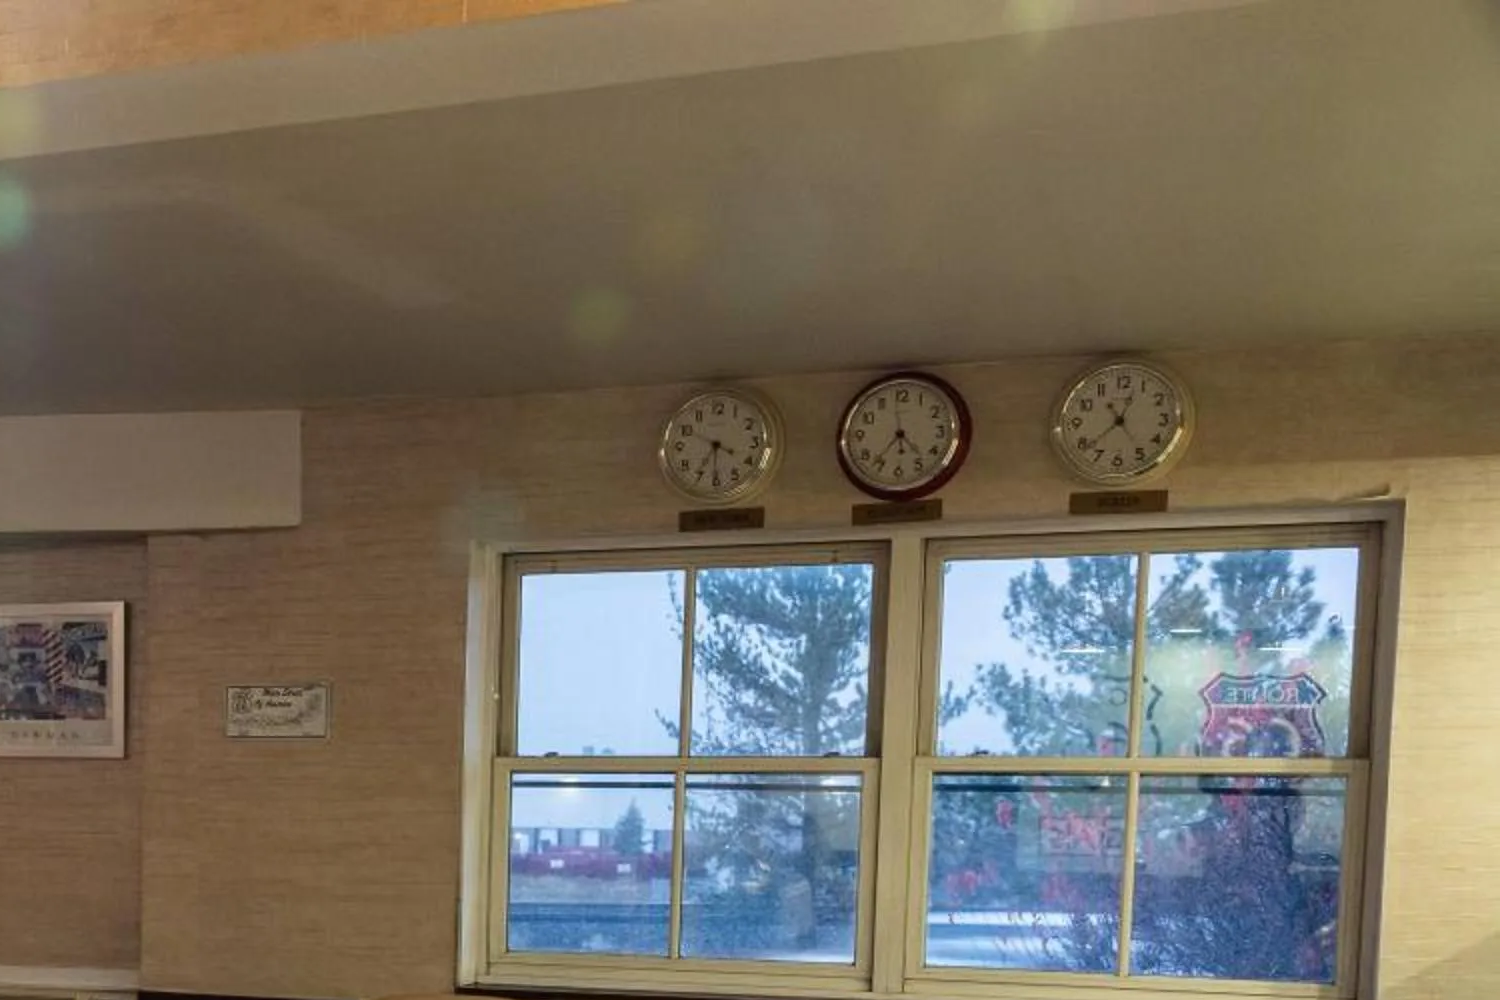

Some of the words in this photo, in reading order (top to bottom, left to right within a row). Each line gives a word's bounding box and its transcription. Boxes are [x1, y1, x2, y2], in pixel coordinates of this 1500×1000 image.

[1117, 376, 1131, 389] 12
[896, 390, 909, 403] 12
[1097, 383, 1105, 397] 11
[878, 397, 886, 410] 11
[1080, 398, 1093, 412] 10
[1154, 393, 1164, 406] 2
[712, 402, 724, 415] 12
[931, 405, 940, 419] 2
[695, 409, 703, 422] 11
[863, 411, 875, 425] 10
[1158, 413, 1169, 427] 3
[744, 418, 754, 431] 2
[1072, 417, 1083, 430] 9
[681, 424, 693, 437] 10
[855, 428, 865, 441] 9
[936, 425, 945, 438] 3
[675, 440, 685, 451] 9
[749, 436, 759, 449] 3
[1077, 437, 1087, 449] 8
[1151, 433, 1161, 445] 4
[861, 449, 870, 461] 8
[930, 446, 939, 455] 4
[1093, 449, 1104, 462] 7
[1135, 448, 1145, 460] 5
[681, 459, 689, 471] 8
[743, 456, 753, 466] 4
[874, 458, 885, 472] 7
[915, 458, 923, 472] 5
[1111, 452, 1123, 466] 6
[695, 470, 704, 480] 7
[730, 467, 739, 480] 5
[893, 466, 903, 478] 6
[711, 474, 720, 487] 6
